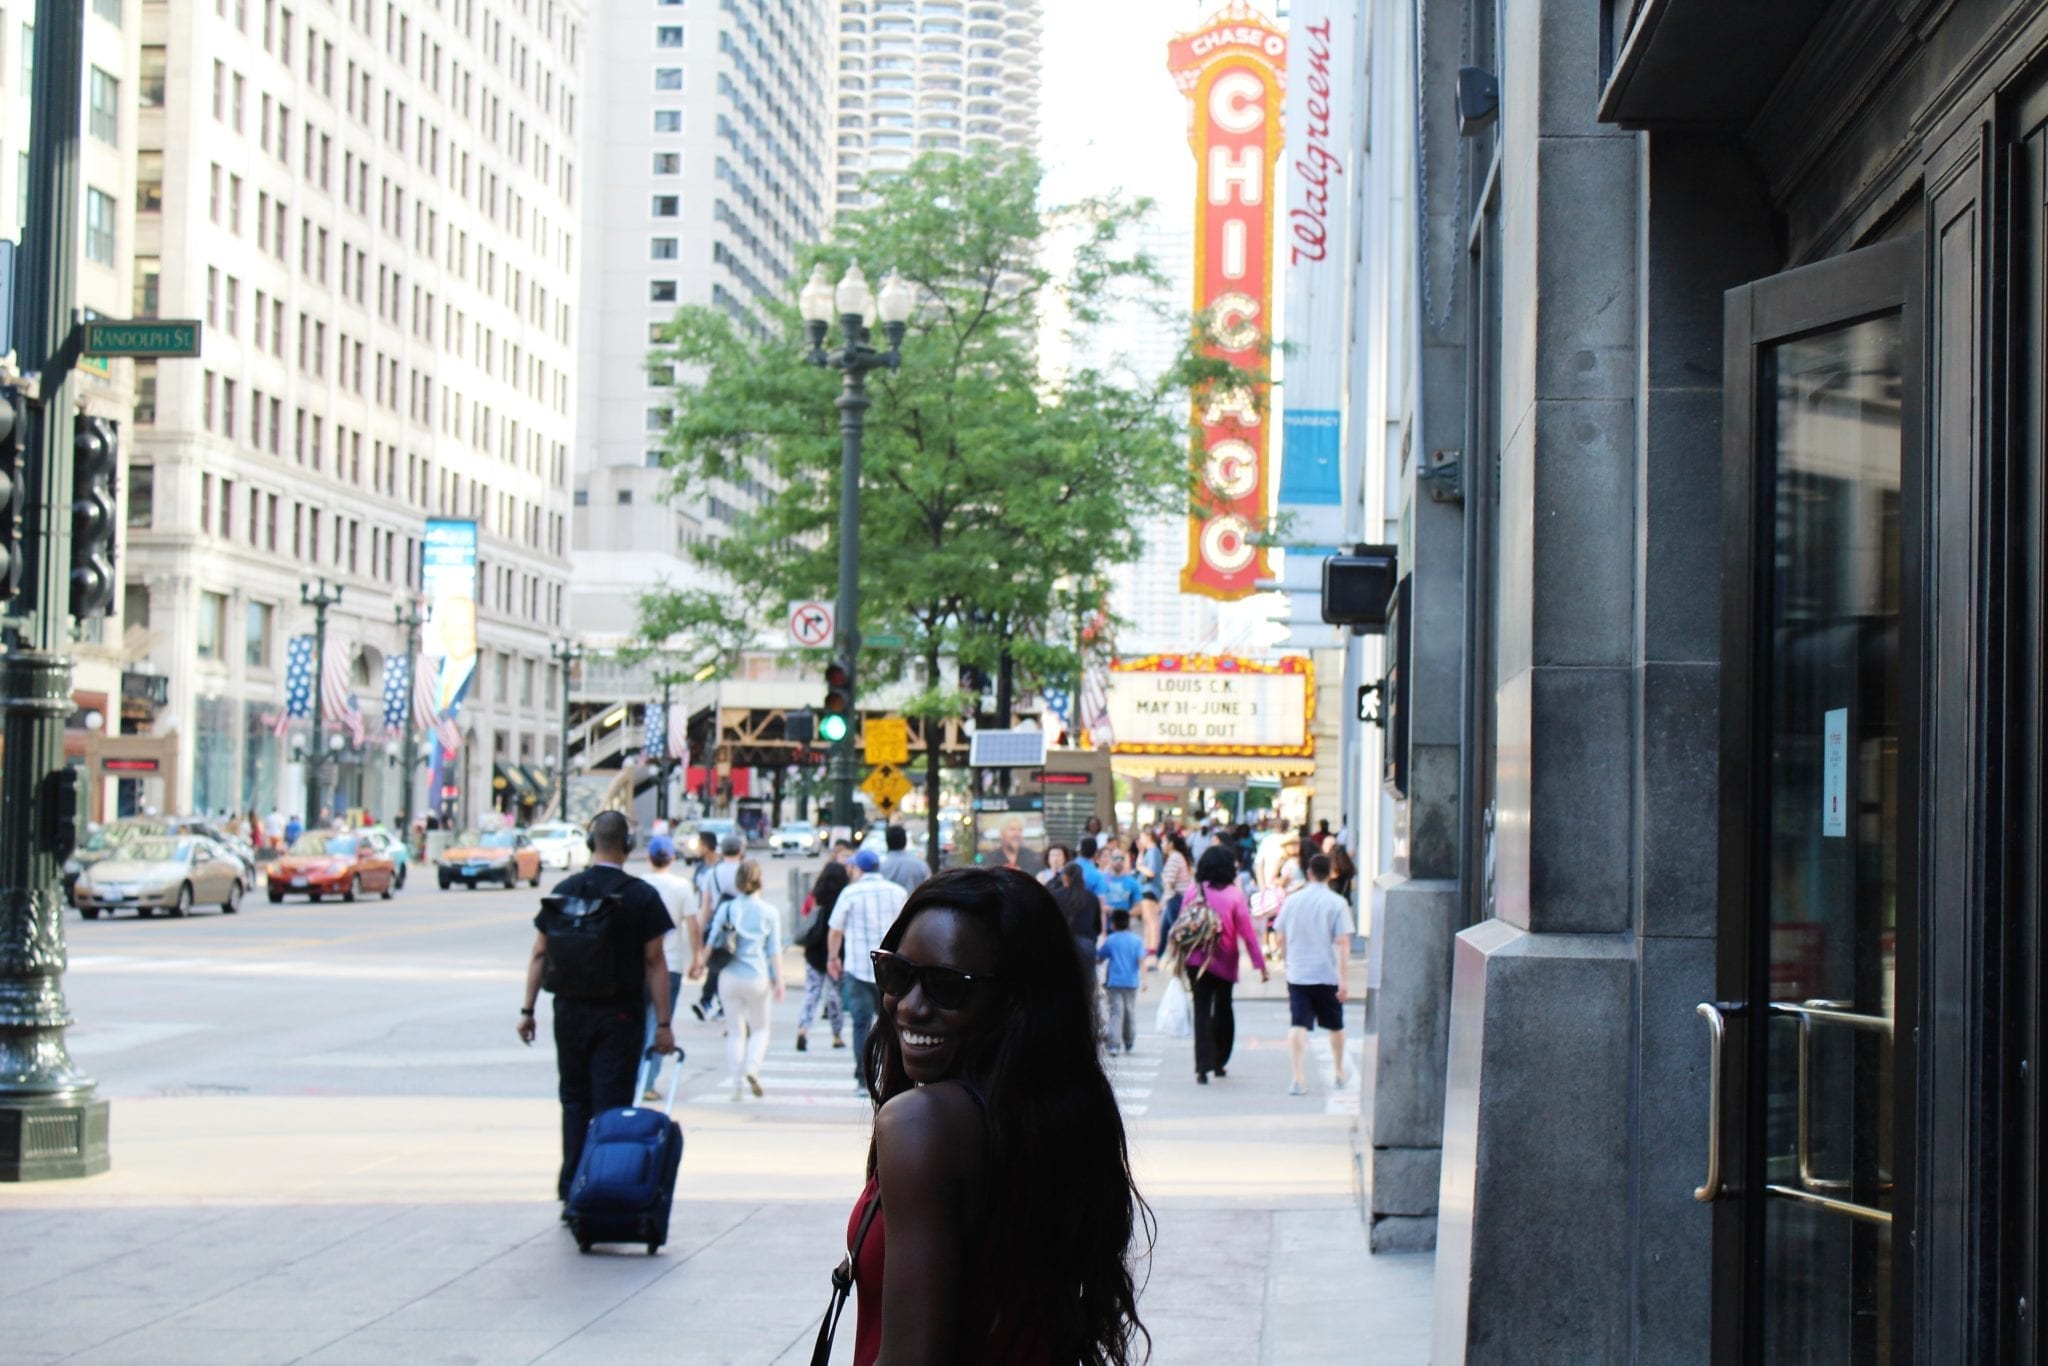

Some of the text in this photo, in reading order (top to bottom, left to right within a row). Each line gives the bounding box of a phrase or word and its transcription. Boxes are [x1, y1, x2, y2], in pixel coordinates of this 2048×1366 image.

[1191, 27, 1264, 56] CHASE
[1290, 16, 1343, 266] Walgreens
[1200, 72, 1265, 574] CHICAGO
[1156, 679, 1202, 693] LOUIS
[1136, 701, 1169, 714] MAY
[1158, 723, 1237, 738] SOLD OUT
